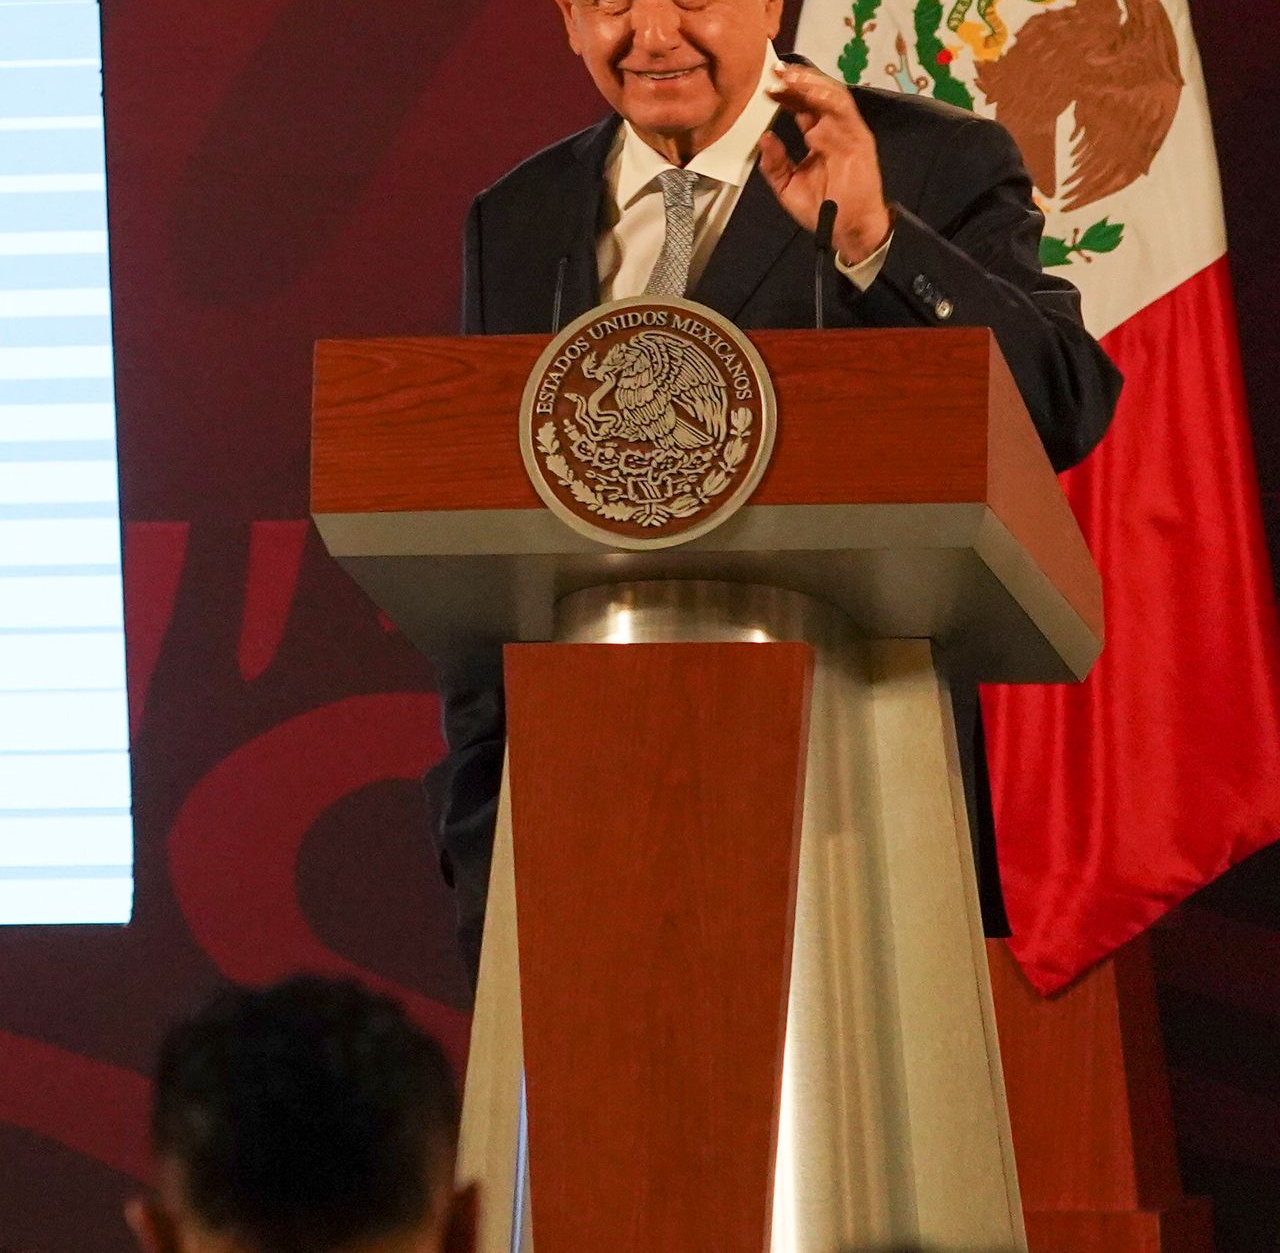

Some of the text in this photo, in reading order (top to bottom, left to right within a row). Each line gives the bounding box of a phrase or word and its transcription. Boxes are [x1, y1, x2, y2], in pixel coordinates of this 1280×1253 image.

[536, 311, 753, 415] ESTADOS UNIDOS MEXICANOS
